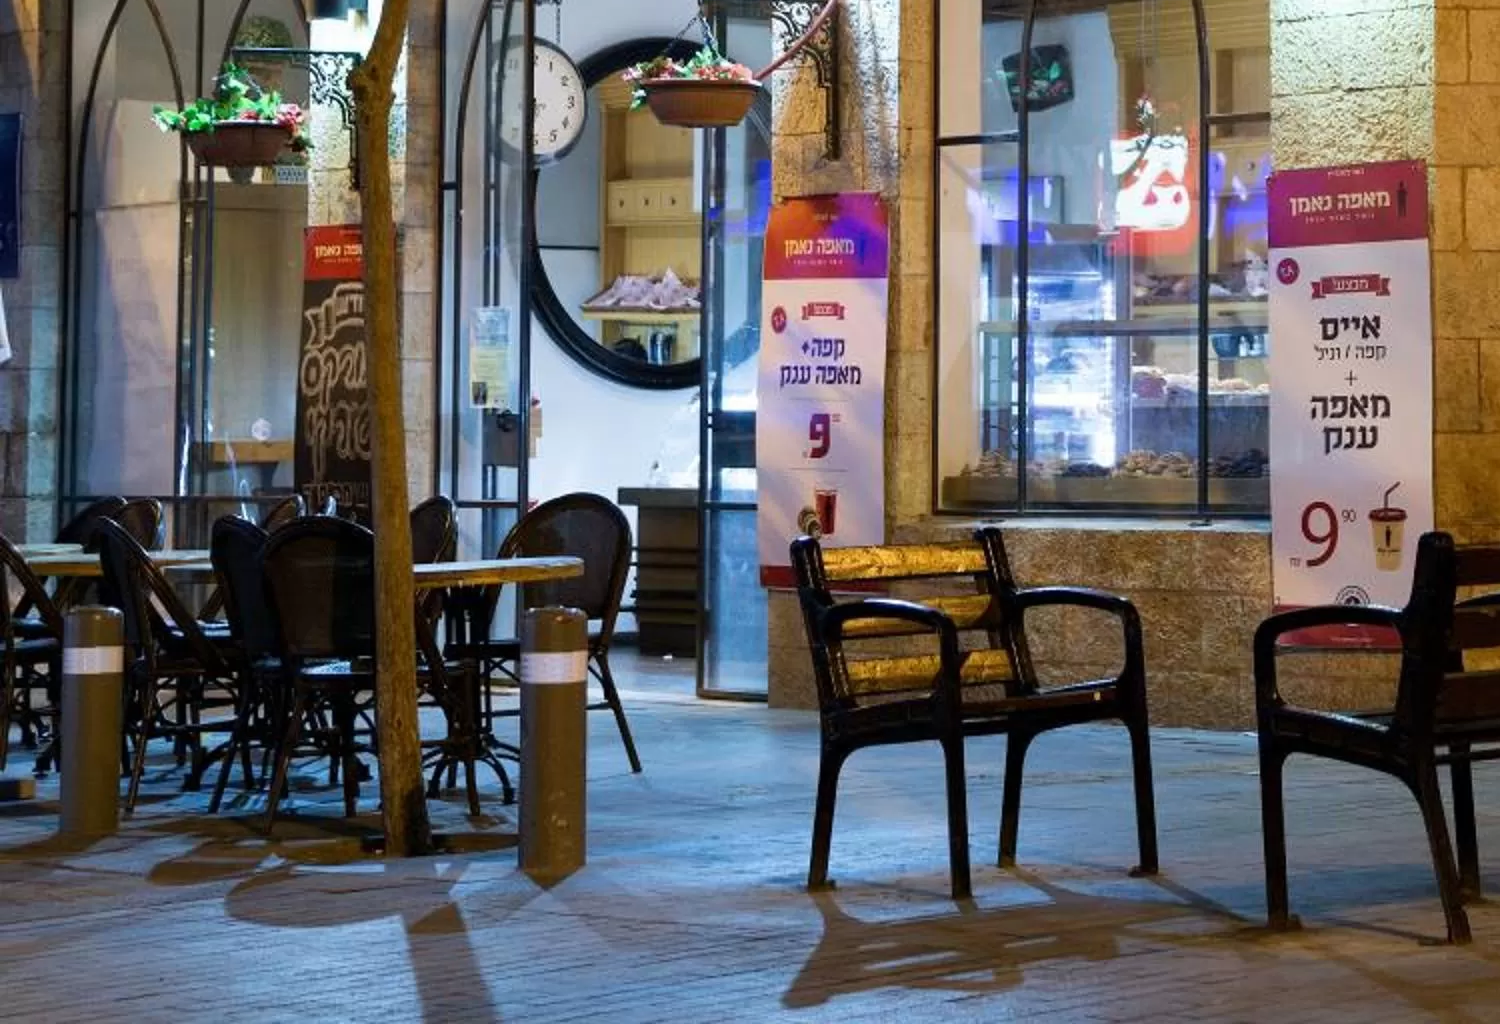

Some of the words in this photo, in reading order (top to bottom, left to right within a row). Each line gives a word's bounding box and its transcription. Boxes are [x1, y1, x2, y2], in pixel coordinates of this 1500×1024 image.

[1288, 195, 1333, 217] נאמן
[1337, 191, 1391, 211] מאפה
[784, 239, 813, 258] נאמן
[816, 239, 855, 256] מאפה
[1319, 315, 1381, 341] אייס
[1355, 345, 1387, 361] קפה
[779, 364, 812, 391] ענק
[815, 365, 862, 385] מאפה
[1310, 394, 1392, 420] מאפה
[809, 413, 831, 459] 9
[1322, 426, 1379, 455] ענק
[1301, 501, 1339, 568] 9
[1341, 509, 1357, 523] 90
